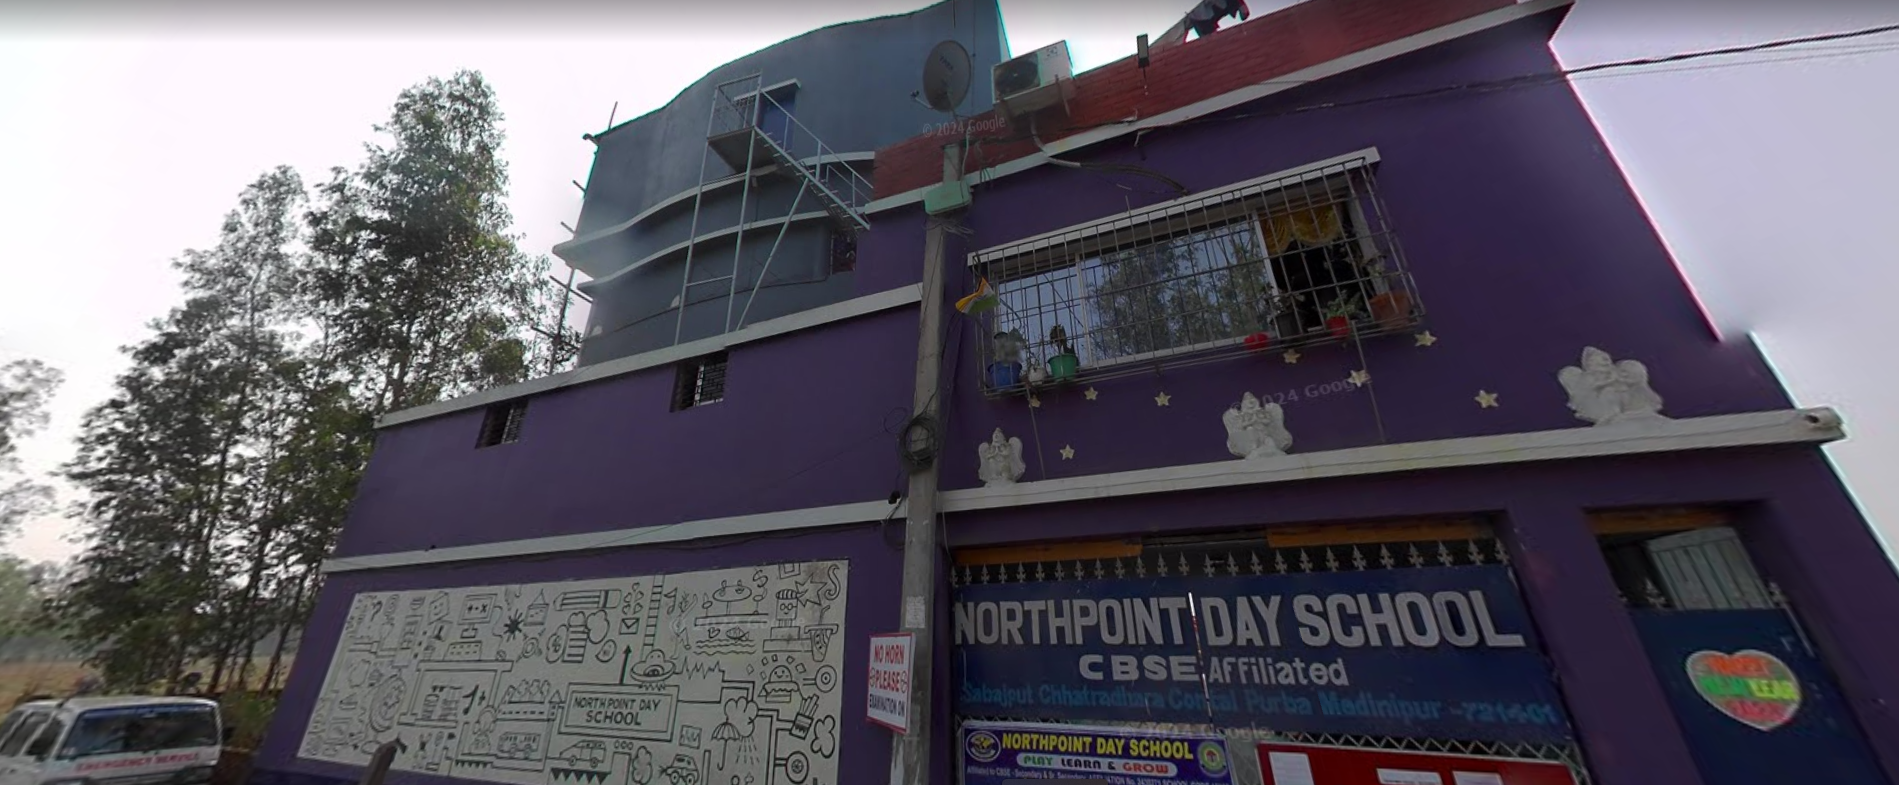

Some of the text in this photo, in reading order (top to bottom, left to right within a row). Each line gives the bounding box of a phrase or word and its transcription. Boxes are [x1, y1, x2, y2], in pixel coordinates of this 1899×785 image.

[954, 597, 1189, 645] NORTHPOINT
[1201, 595, 1285, 647] DAY
[1292, 590, 1526, 648] SCHOOL
[874, 644, 905, 665] NO HORN
[1079, 654, 1200, 682] CBSE
[874, 669, 901, 692] PLEASE
[639, 699, 661, 712] DAY
[586, 710, 642, 726] SCHOOL
[1002, 732, 1194, 760] NORTHPOINT DAY SCHOOL
[1023, 755, 1054, 766] PLAY
[1107, 761, 1117, 771] &
[1123, 762, 1169, 775] GROW
